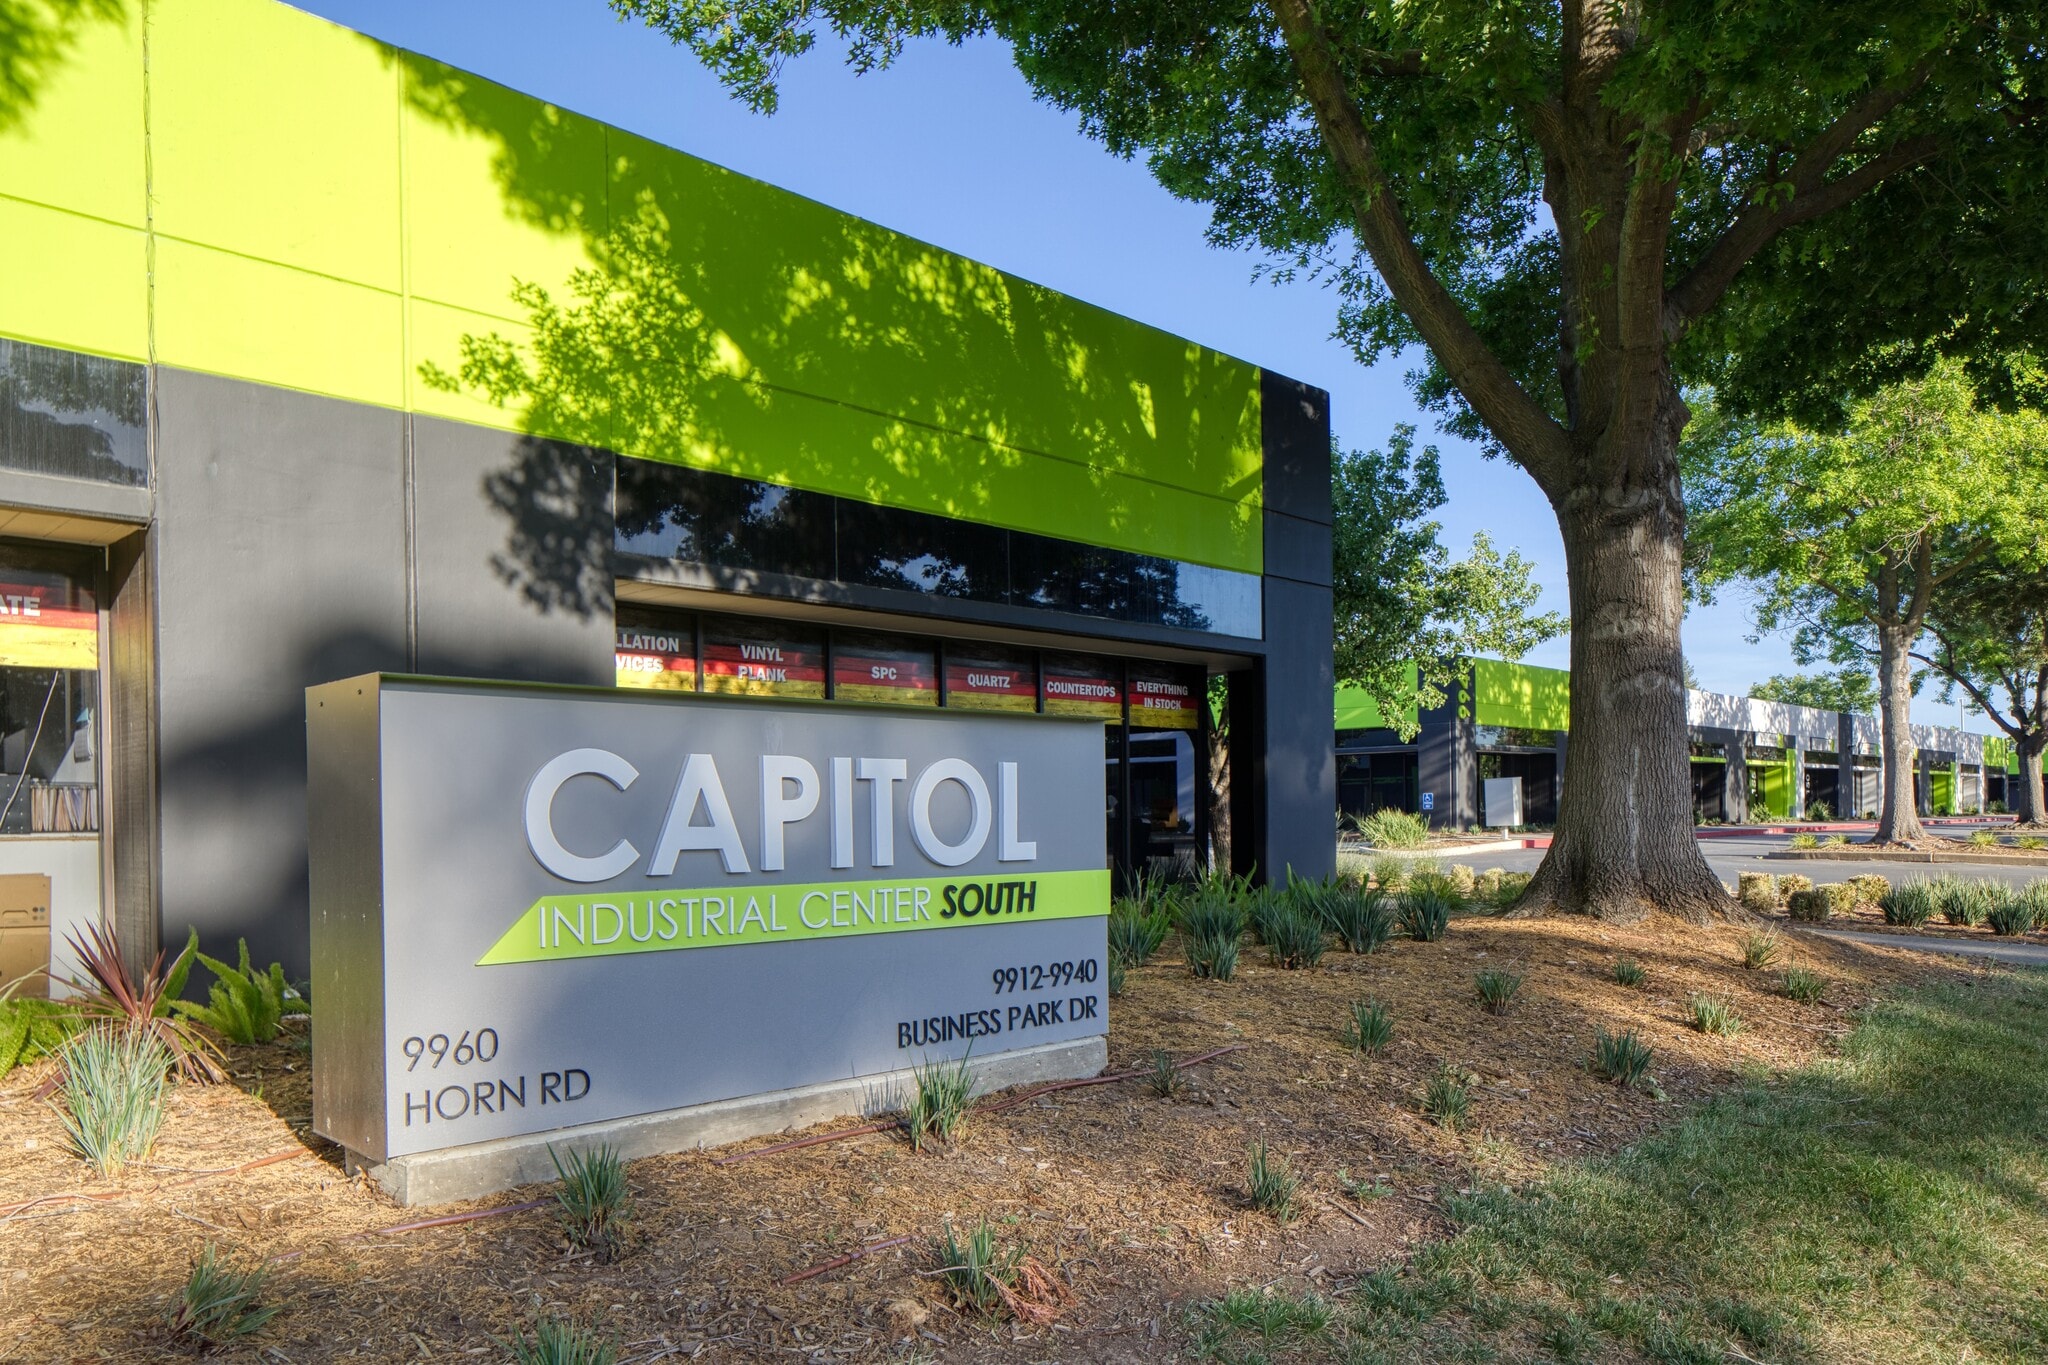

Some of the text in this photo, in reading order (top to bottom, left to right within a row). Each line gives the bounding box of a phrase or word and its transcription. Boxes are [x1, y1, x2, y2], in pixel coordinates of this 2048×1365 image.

[740, 645, 784, 662] VINYL
[738, 665, 787, 682] PLANK
[871, 666, 898, 680] SPC
[967, 673, 1011, 689] QUARTZ
[1046, 681, 1116, 698] COUNTERTOPS
[1136, 681, 1189, 697] EVERYTHING
[1144, 698, 1182, 711] IN STOCK
[523, 747, 1038, 883] CAPITOL
[538, 881, 1037, 948] INDUSTRIAL CENTER SOUTH
[991, 958, 1098, 995] 9912-9940
[898, 995, 1098, 1049] BUSINESS PARK DR
[402, 1027, 499, 1073] 9960
[404, 1068, 591, 1127] HORN RD
